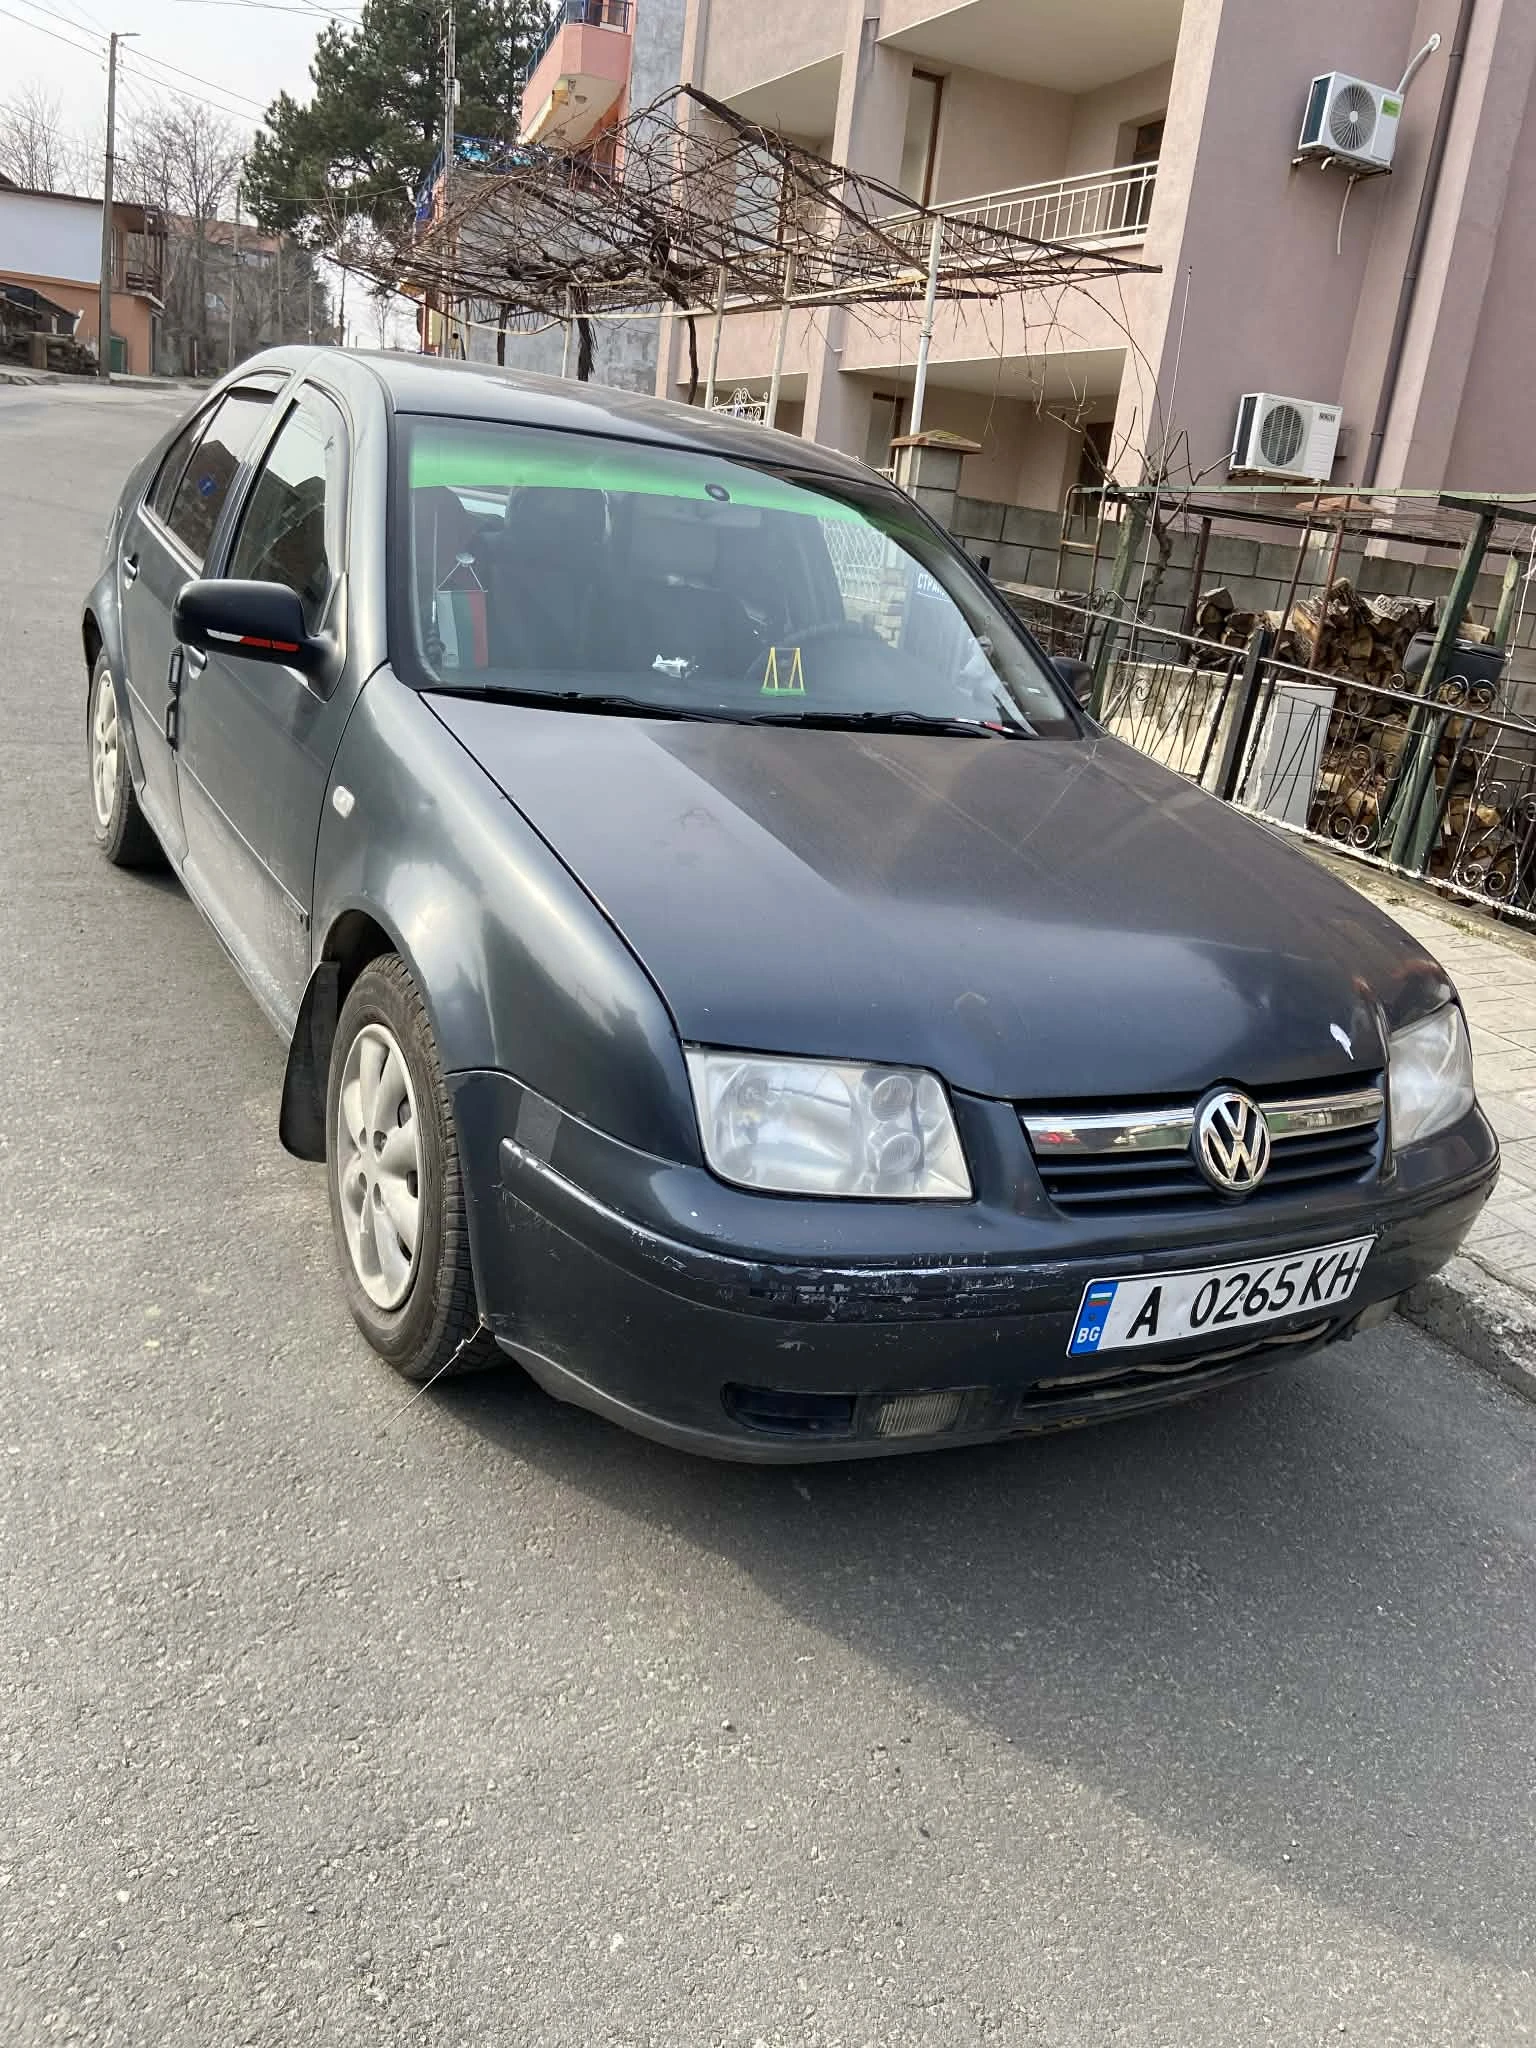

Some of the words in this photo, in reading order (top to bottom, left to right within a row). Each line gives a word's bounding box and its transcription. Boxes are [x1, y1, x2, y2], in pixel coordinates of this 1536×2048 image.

[1200, 1092, 1271, 1191] VW
[1077, 1326, 1100, 1344] BG
[1126, 1285, 1162, 1339] A
